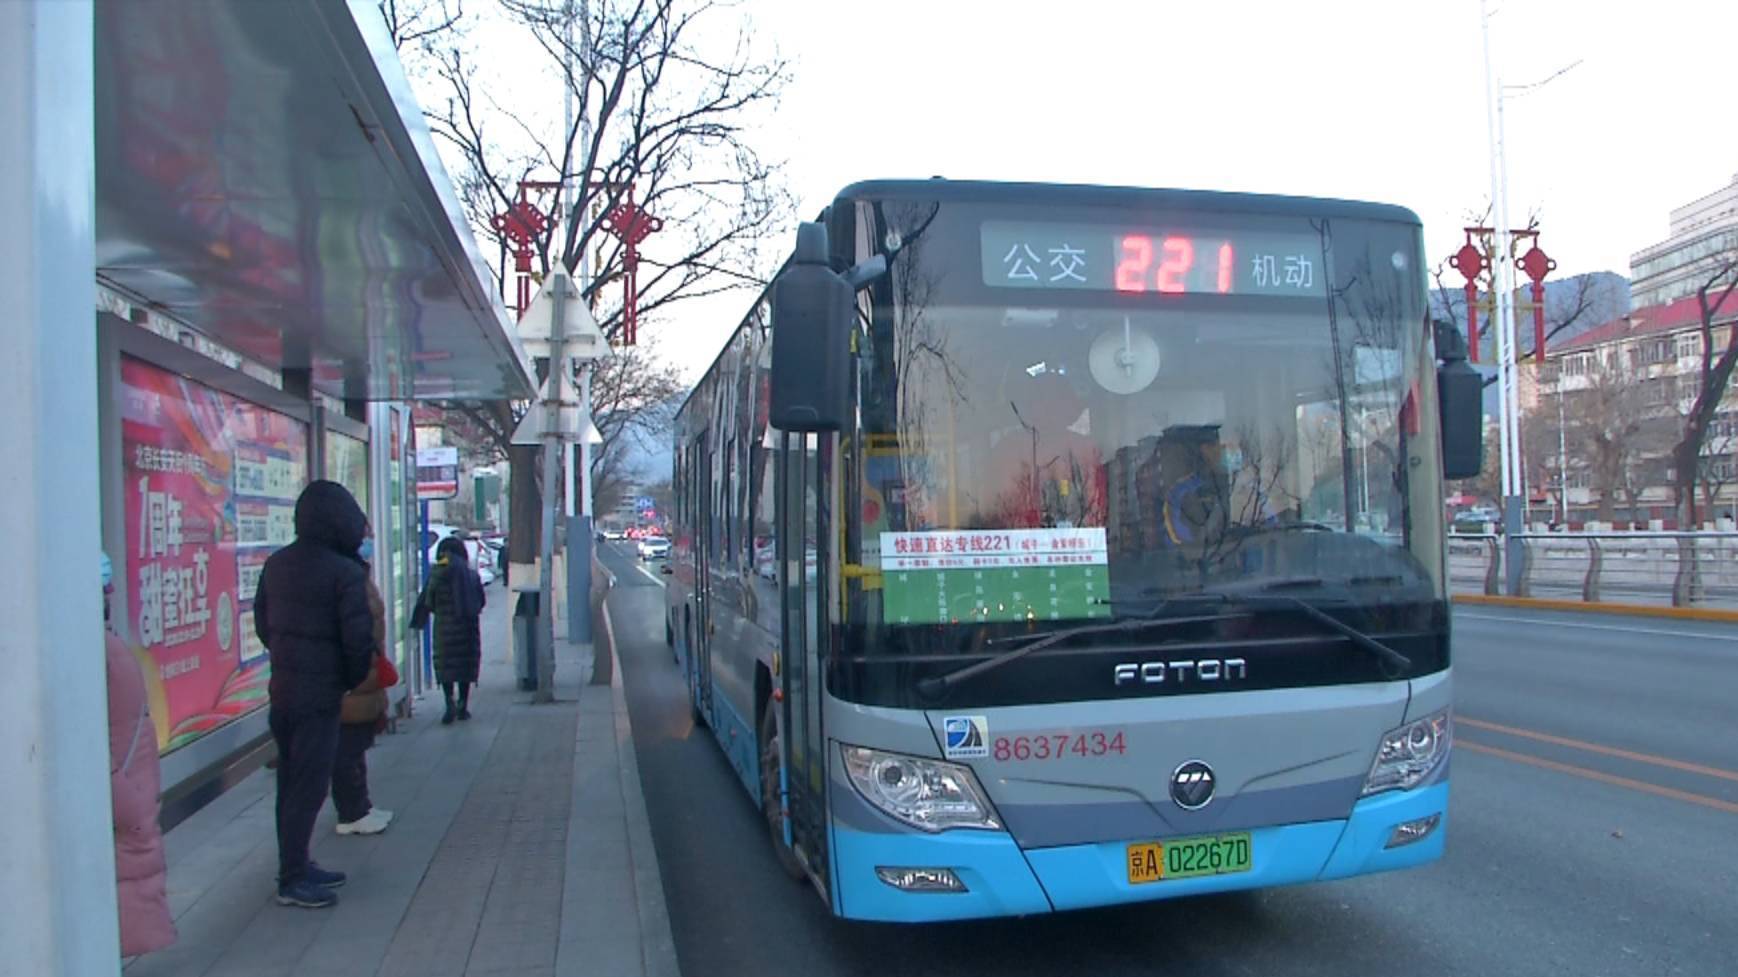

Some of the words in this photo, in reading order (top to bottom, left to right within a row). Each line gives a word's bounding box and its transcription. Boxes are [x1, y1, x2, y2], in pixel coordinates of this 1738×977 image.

[1004, 243, 1087, 282] 公交
[1115, 235, 1235, 294] 221
[1251, 253, 1314, 288] 机动
[138, 475, 183, 560] 1周年
[894, 535, 1012, 554] 快速直达专线221
[1114, 658, 1246, 685] FOTON
[993, 731, 1127, 762] 8637434
